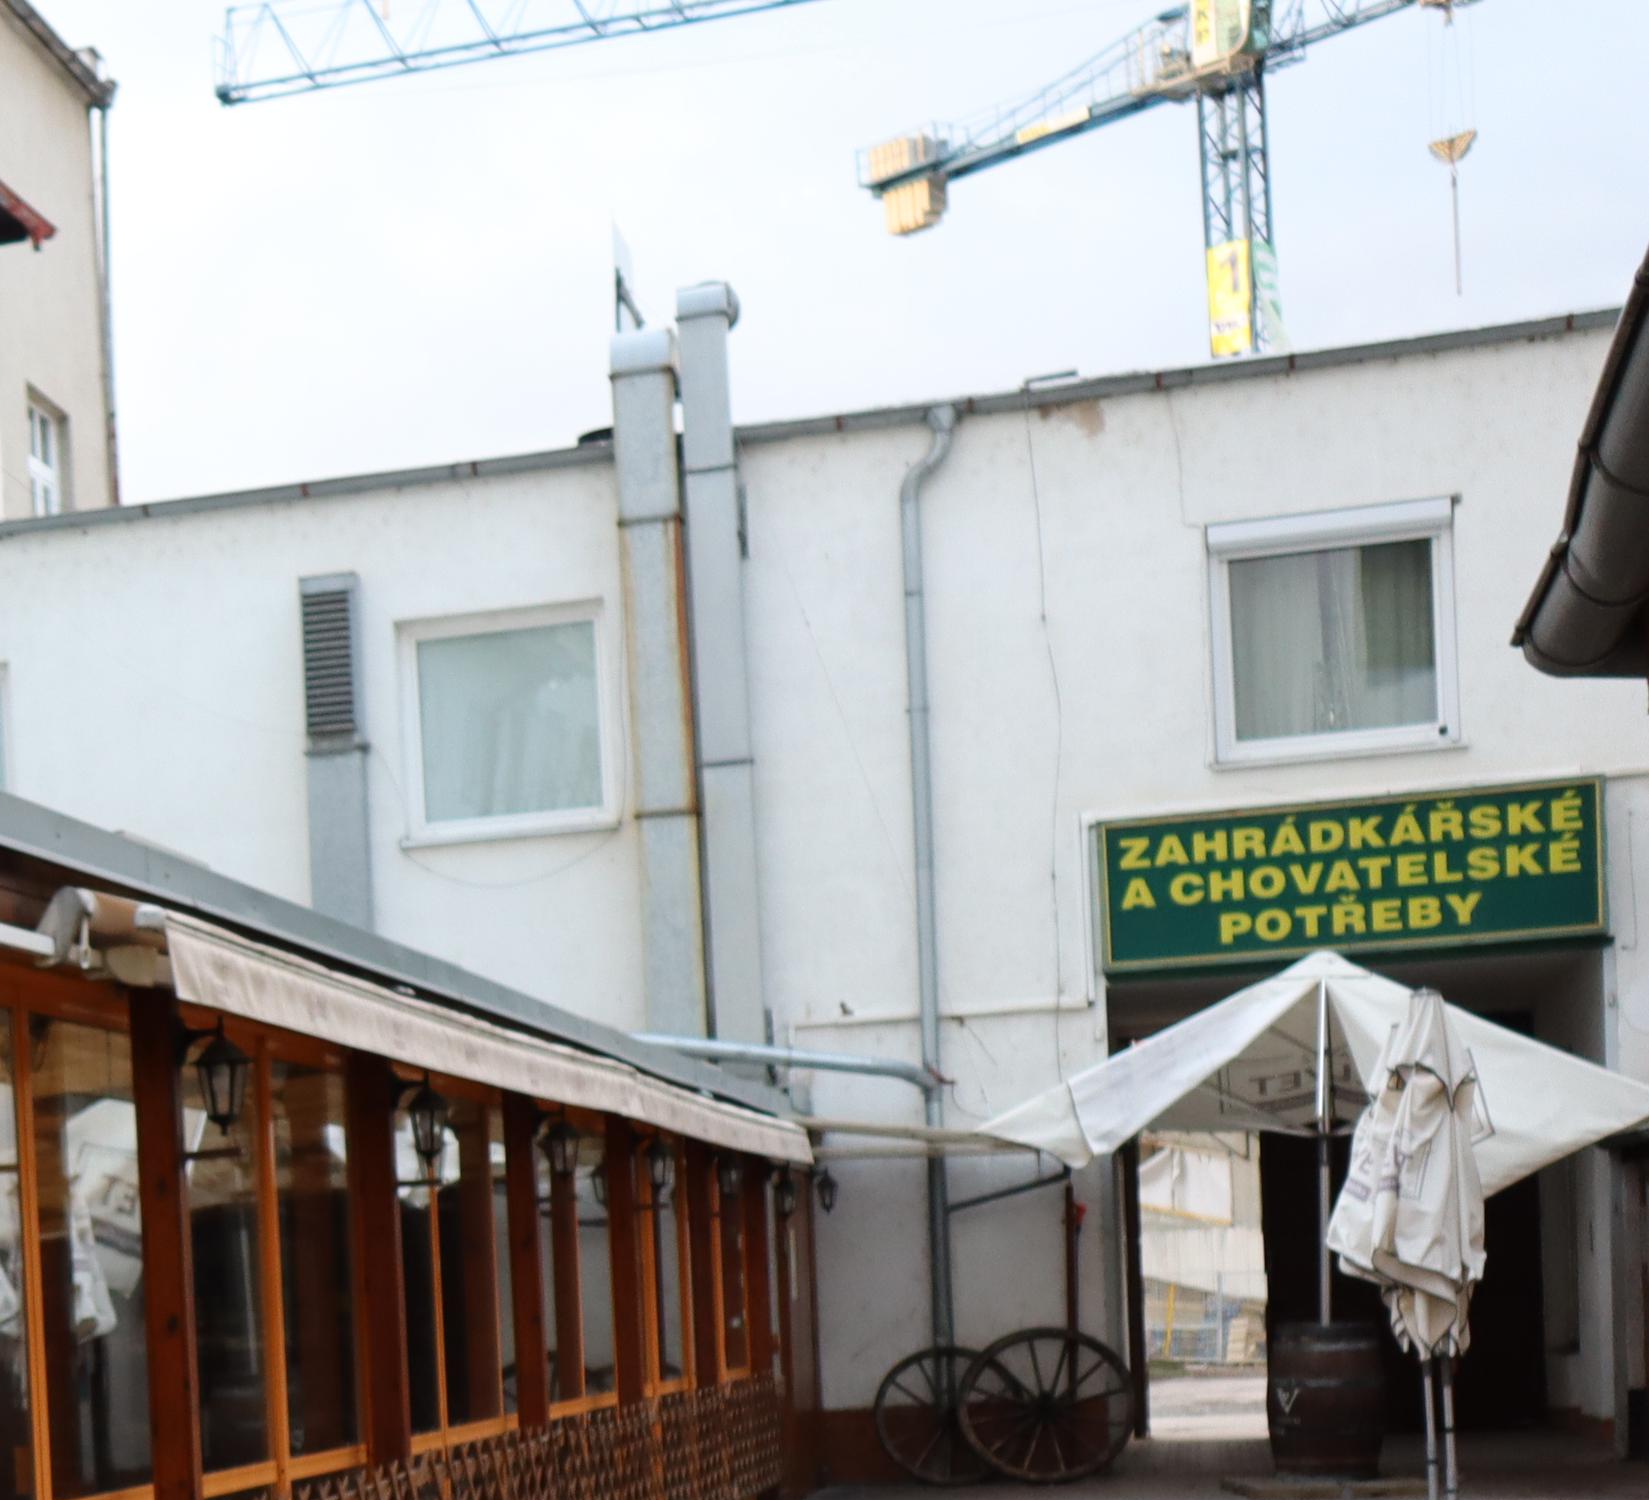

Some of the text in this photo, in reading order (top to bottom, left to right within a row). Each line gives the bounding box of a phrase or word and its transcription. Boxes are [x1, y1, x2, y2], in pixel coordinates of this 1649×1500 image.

[1118, 791, 1584, 870] ZAHRÁDKÁŘSKÉ
[1120, 833, 1582, 910] A CHOVATELSKÉ
[1219, 893, 1482, 944] POTŘEBY
